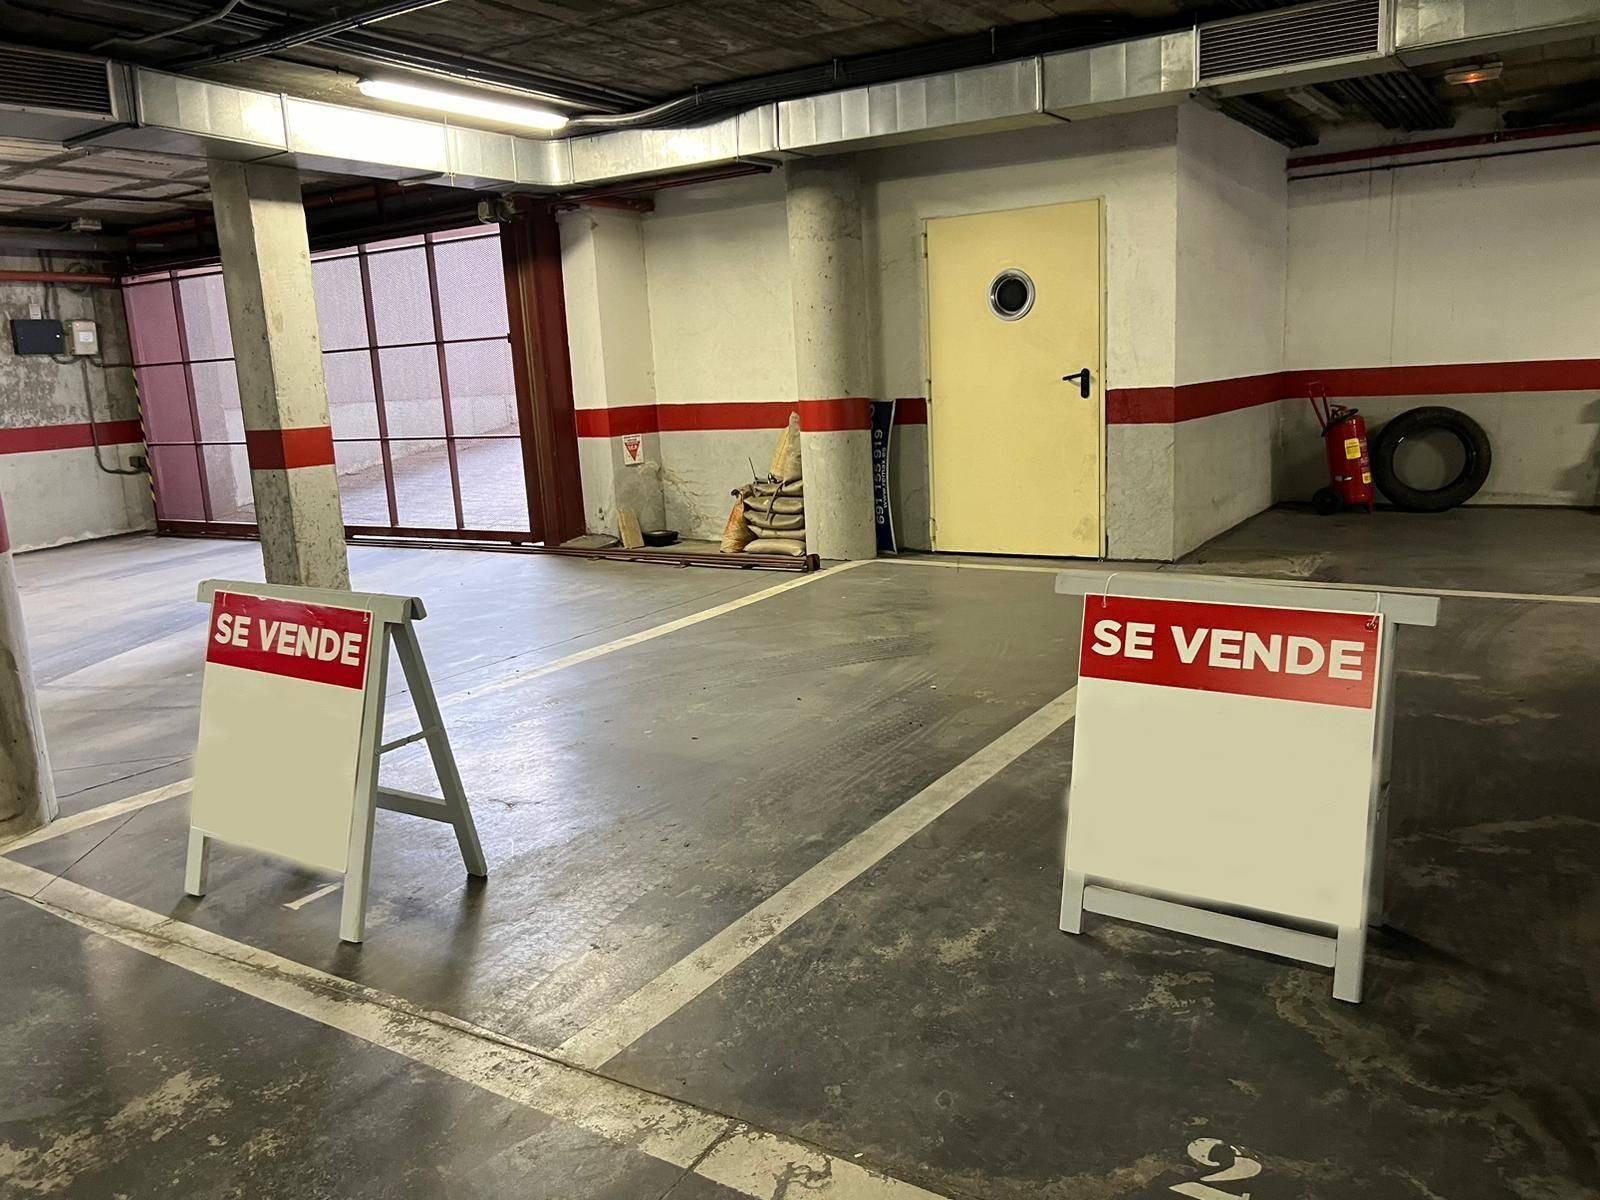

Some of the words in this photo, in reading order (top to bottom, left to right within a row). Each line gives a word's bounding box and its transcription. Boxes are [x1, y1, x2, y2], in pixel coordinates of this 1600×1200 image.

[875, 498, 885, 525] 691
[214, 612, 251, 648] SE
[259, 619, 363, 667] VENDE
[1091, 619, 1156, 660] SE
[1170, 625, 1365, 681] VENDE
[1168, 1137, 1262, 1200] 2
